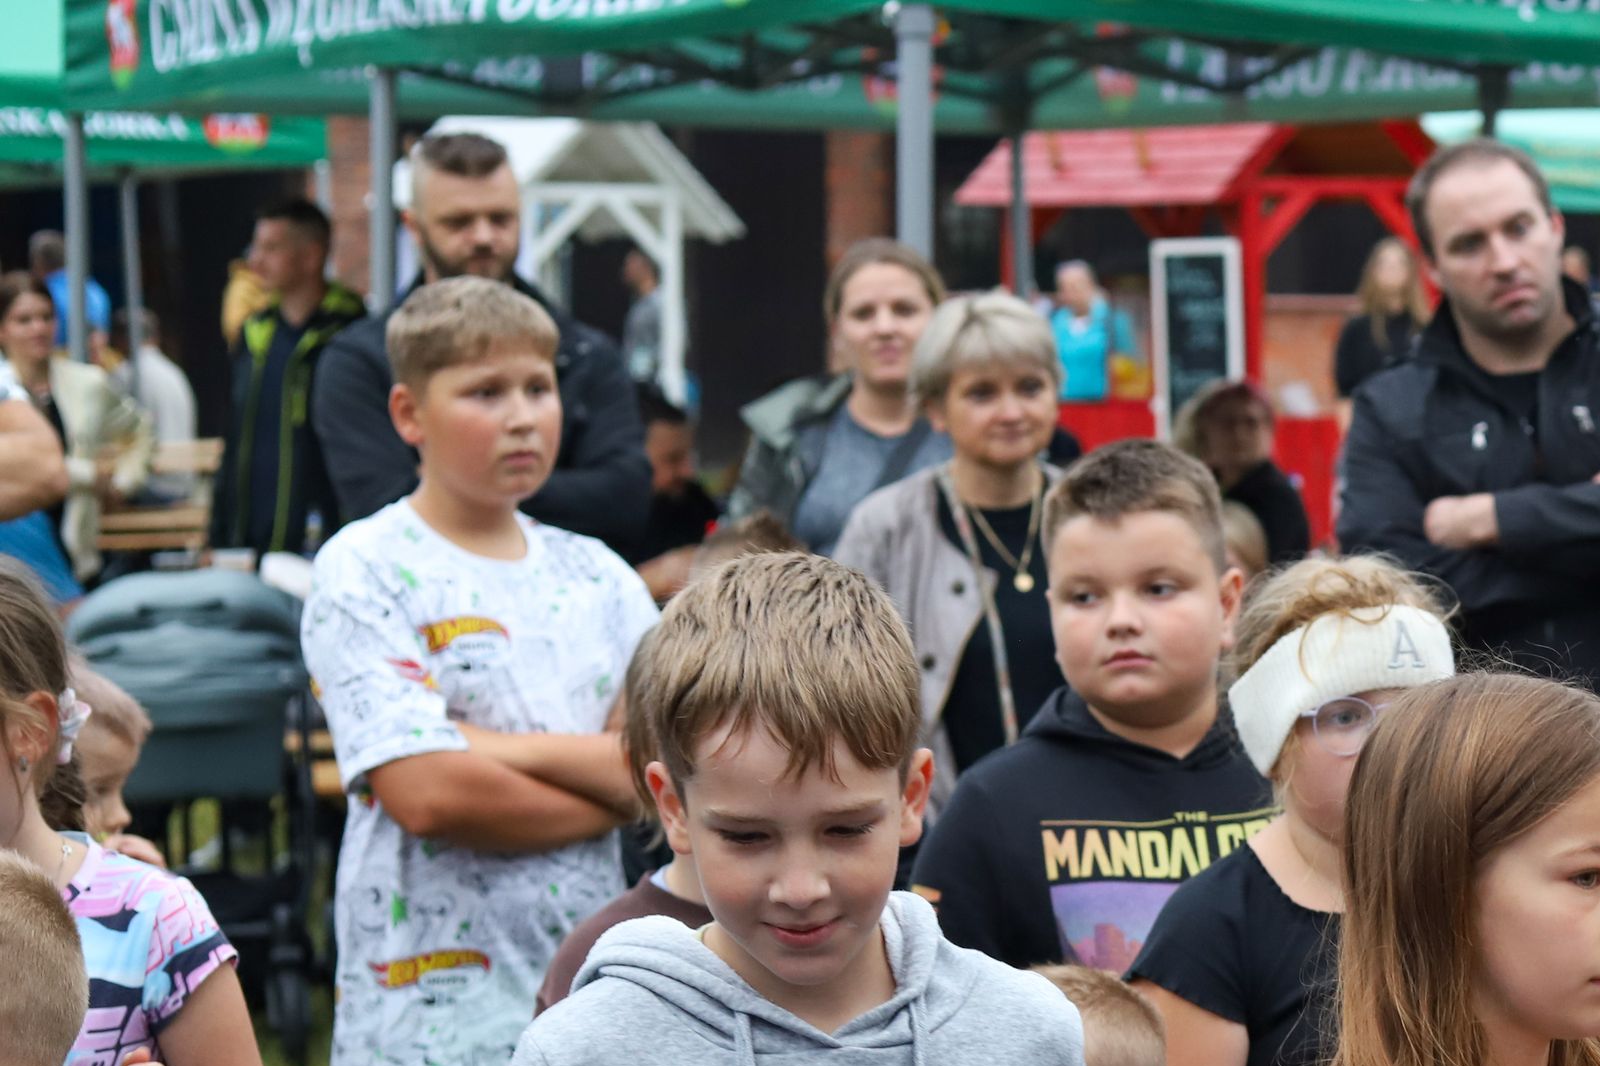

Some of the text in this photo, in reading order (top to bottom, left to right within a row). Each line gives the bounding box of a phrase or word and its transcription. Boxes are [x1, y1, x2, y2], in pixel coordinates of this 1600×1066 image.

[1388, 620, 1426, 669] A
[1174, 811, 1208, 823] THE
[1041, 818, 1272, 881] MANDALO
